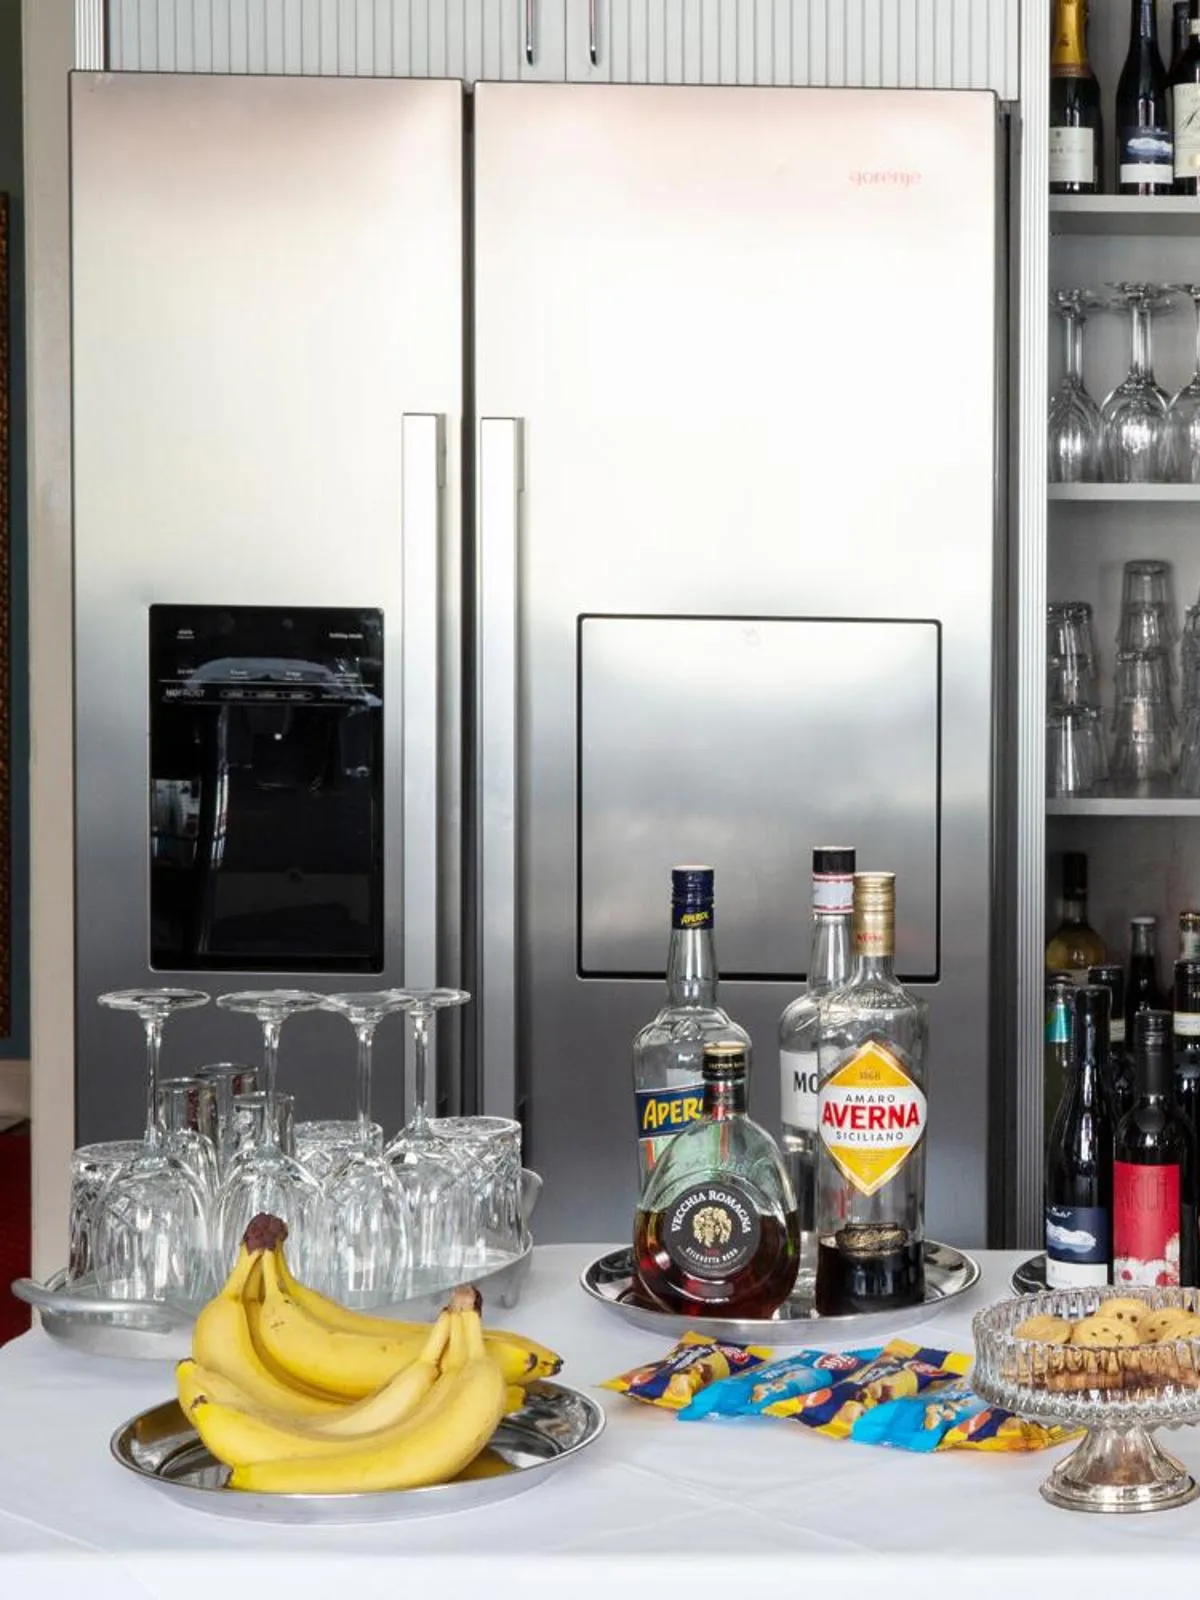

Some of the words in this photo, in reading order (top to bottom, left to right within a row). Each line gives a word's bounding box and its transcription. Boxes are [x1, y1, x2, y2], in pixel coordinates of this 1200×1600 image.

[845, 1093, 896, 1104] AMARO
[821, 1100, 921, 1131] AVERNA
[835, 1130, 905, 1142] SICILIANO
[671, 1191, 707, 1233] VECCHIA
[708, 1189, 752, 1234] ROMAGNA
